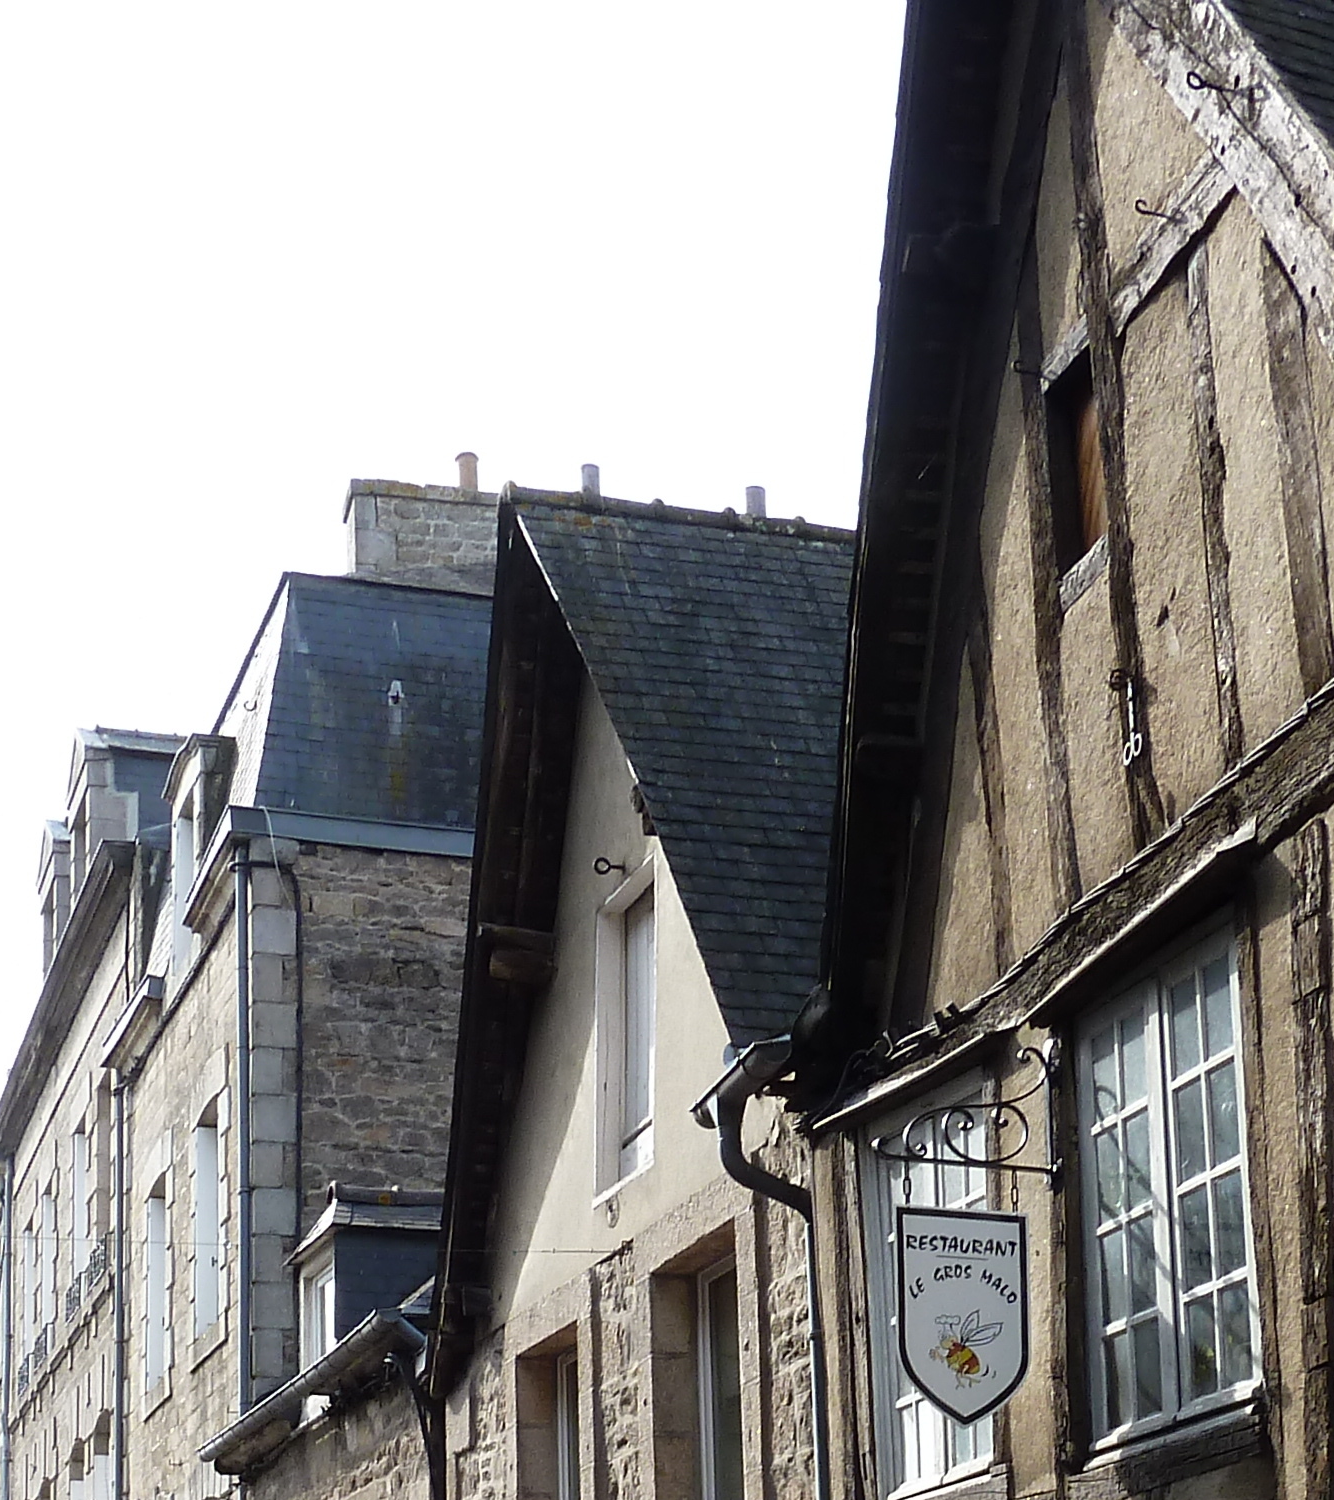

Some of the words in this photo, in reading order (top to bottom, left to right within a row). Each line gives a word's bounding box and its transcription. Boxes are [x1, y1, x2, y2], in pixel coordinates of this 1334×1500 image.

[906, 1234, 1017, 1257] RESTAURANT
[908, 1277, 926, 1299] LE
[933, 1264, 972, 1282] GROS
[980, 1269, 1018, 1304] MALO
